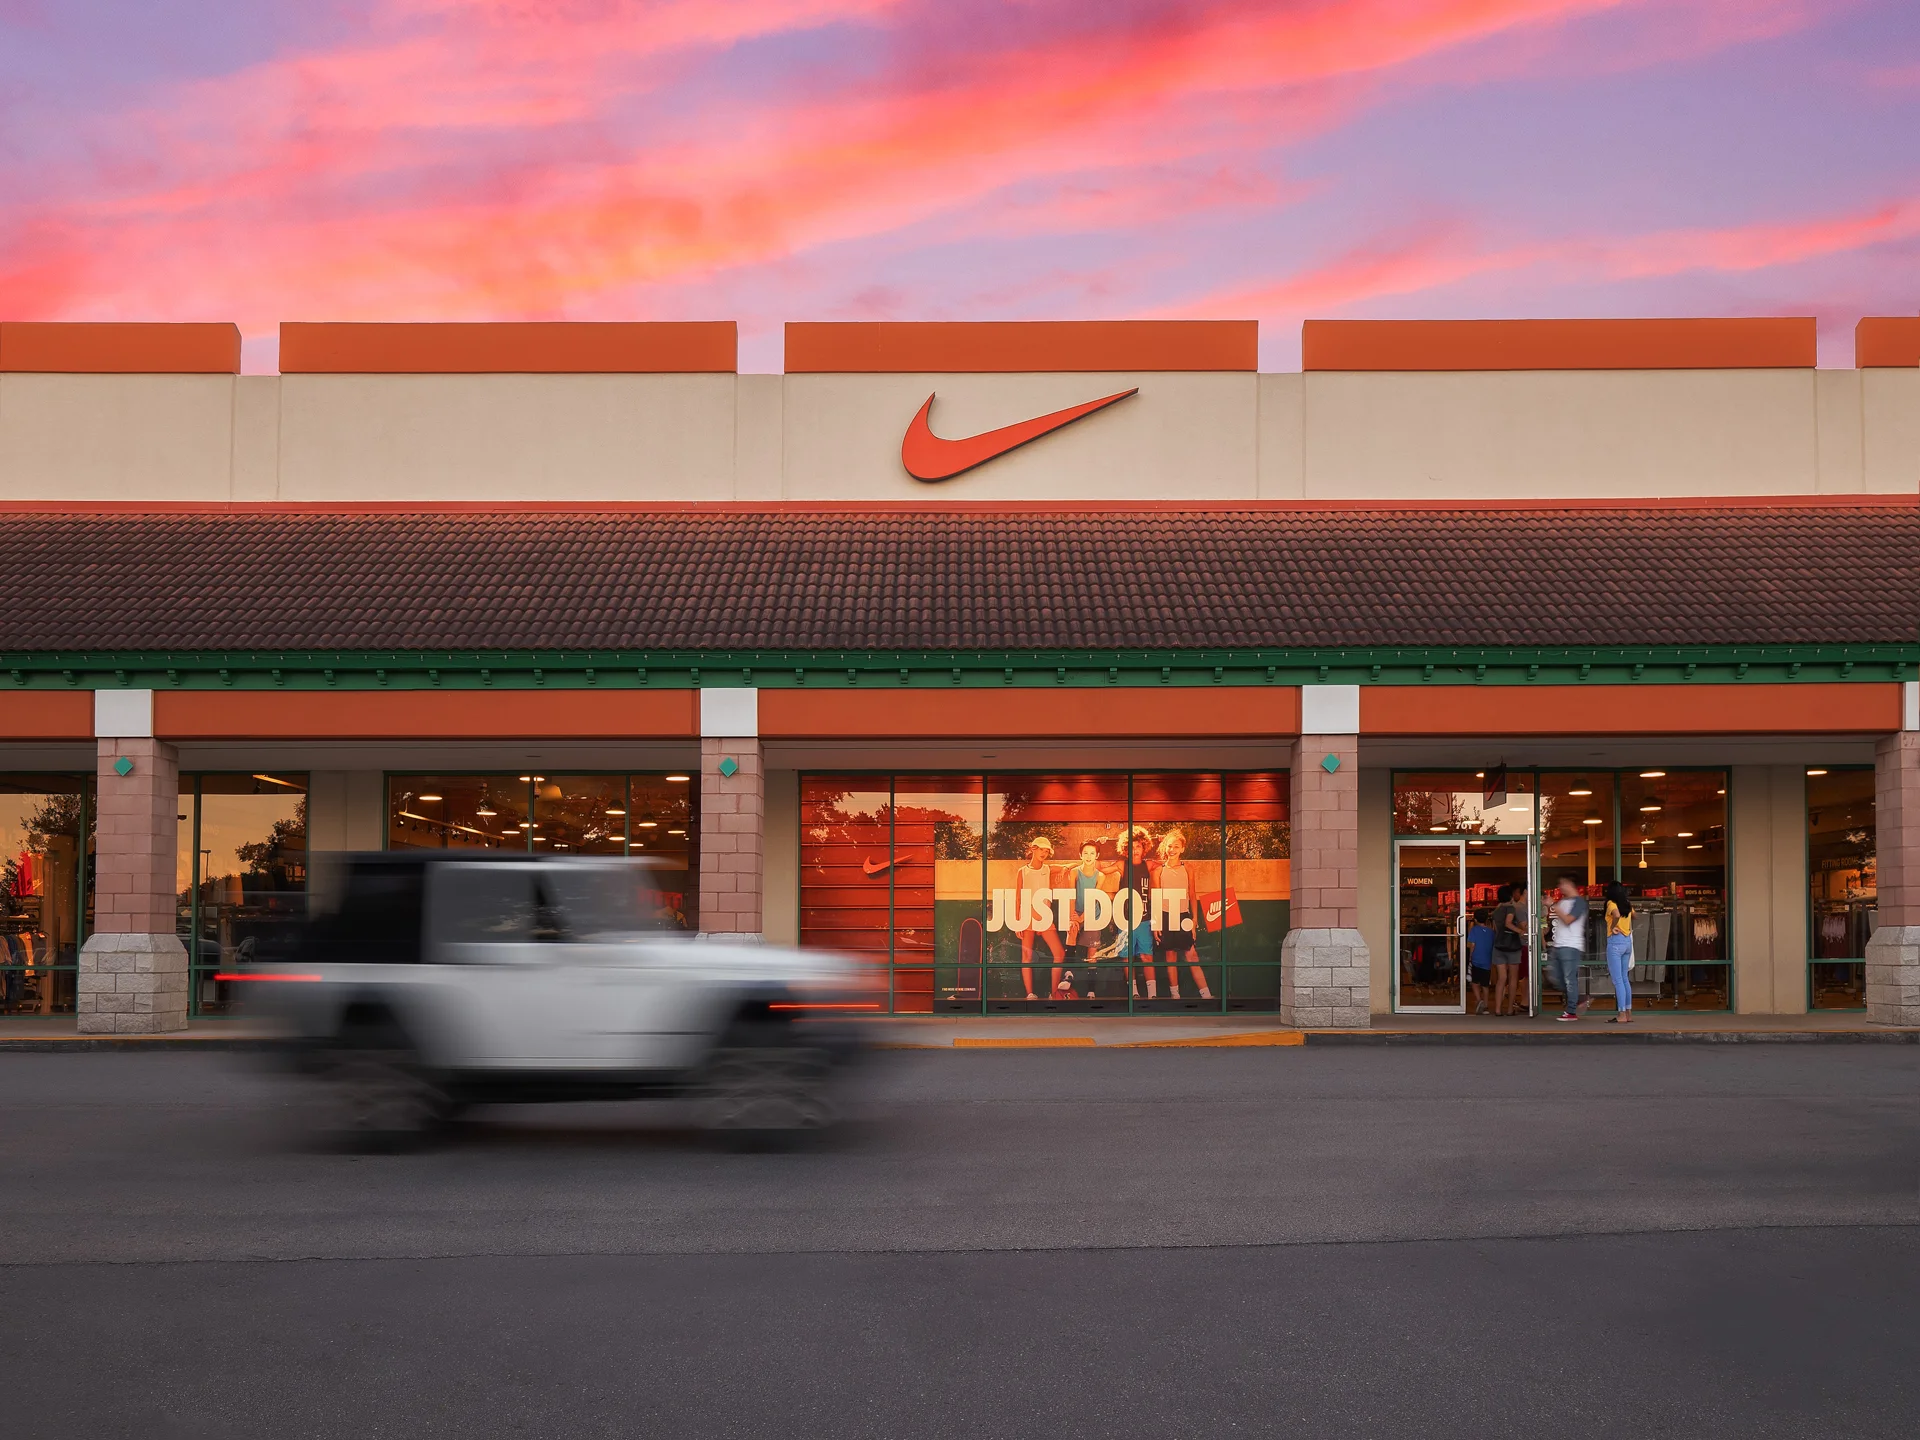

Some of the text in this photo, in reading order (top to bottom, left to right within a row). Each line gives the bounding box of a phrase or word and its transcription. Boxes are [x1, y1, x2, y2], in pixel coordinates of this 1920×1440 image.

[1455, 822, 1472, 830] 701
[1821, 858, 1840, 869] FITTING
[986, 887, 1194, 932] JUST DO IT.
